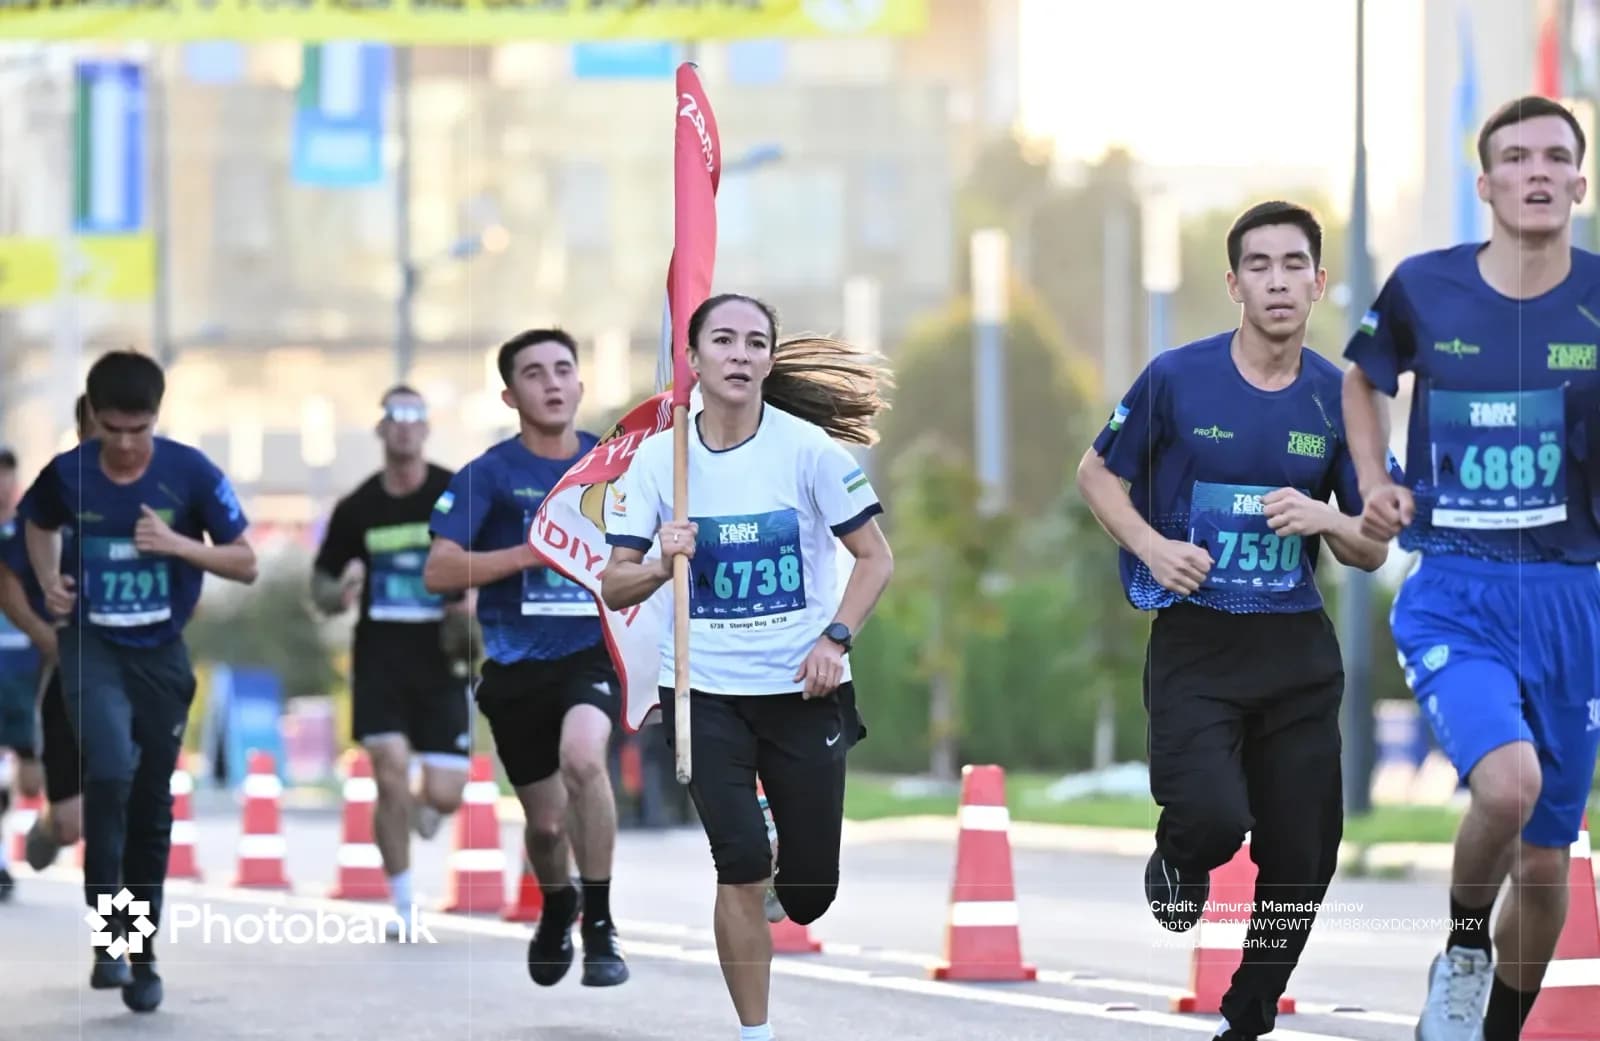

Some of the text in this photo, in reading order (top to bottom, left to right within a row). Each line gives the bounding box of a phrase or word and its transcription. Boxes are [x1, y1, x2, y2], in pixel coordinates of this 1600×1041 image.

[1289, 433, 1321, 446] TASH
[1288, 441, 1320, 455] KENT
[1460, 444, 1561, 490] 6889
[1234, 494, 1265, 504] TAS
[718, 522, 758, 535] TASH
[719, 532, 758, 542] KENT
[1216, 531, 1302, 571] 7530
[714, 554, 801, 599] 6738
[102, 571, 168, 601] 7291
